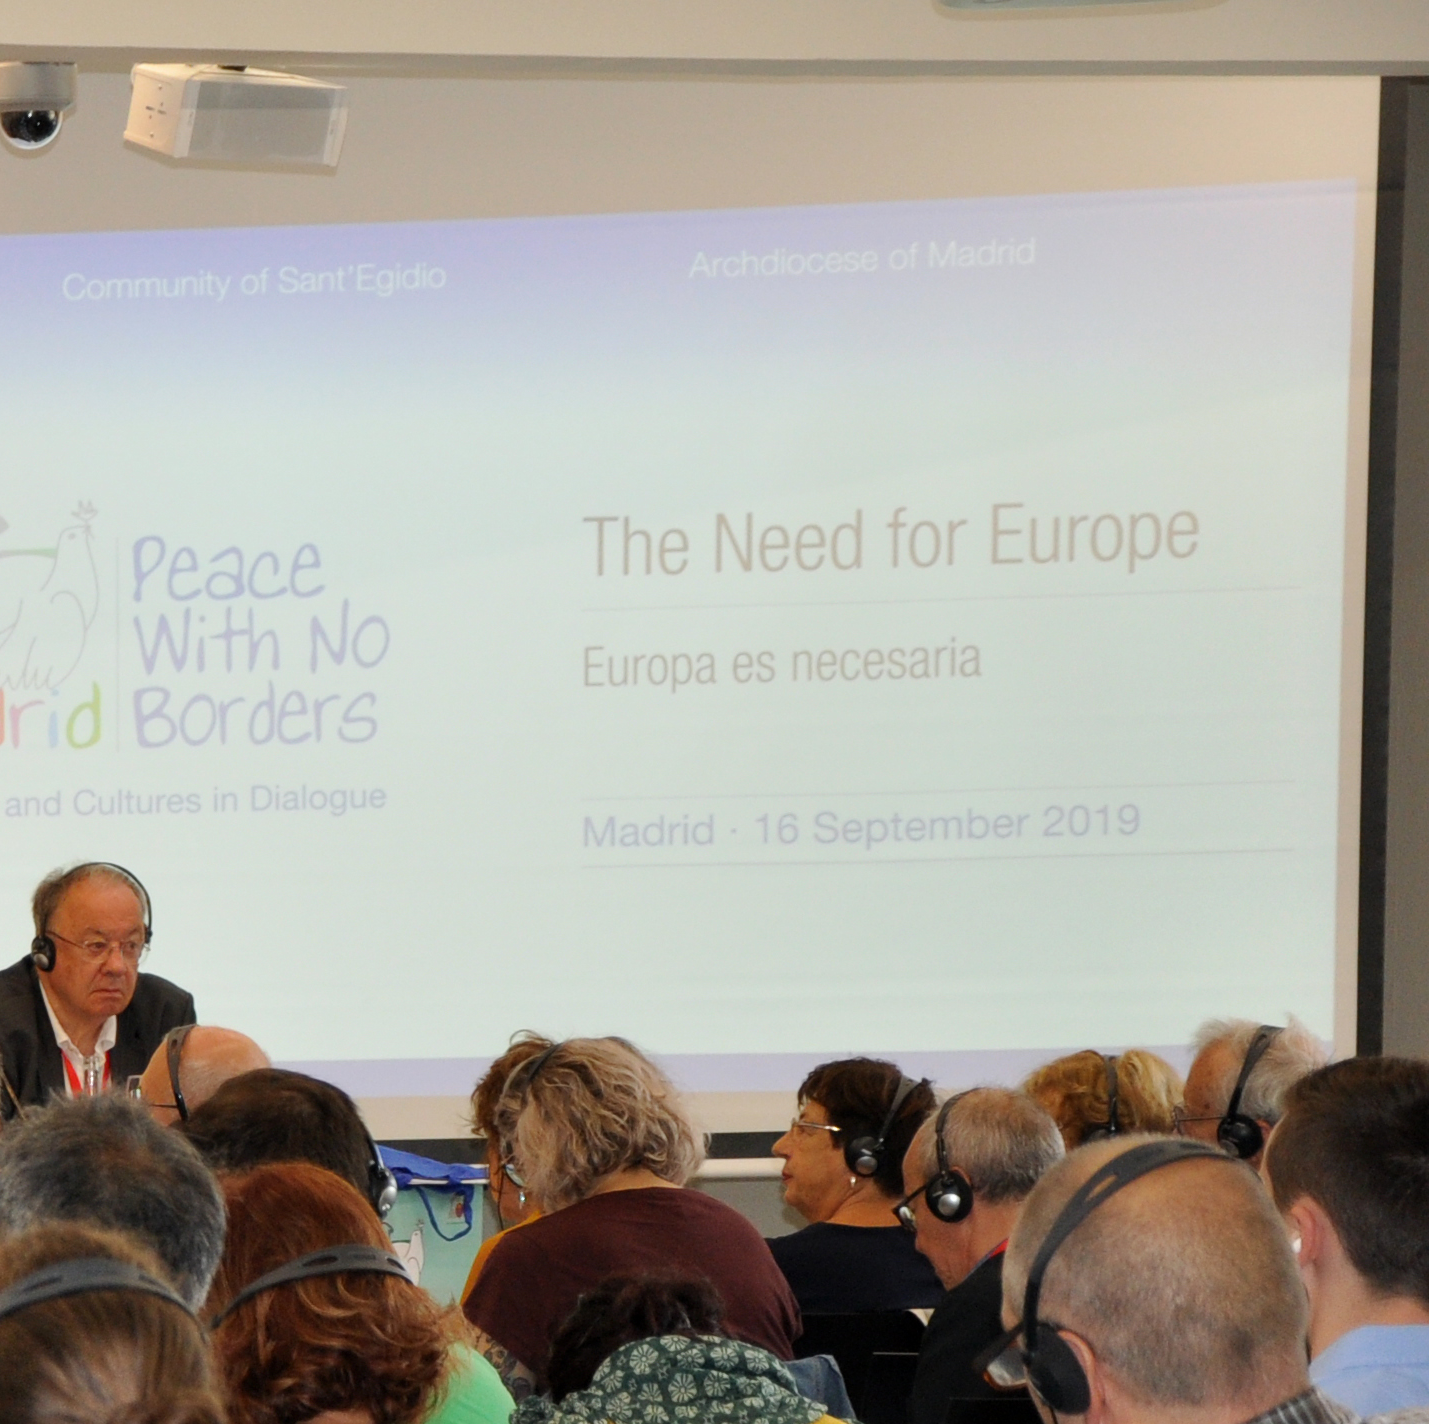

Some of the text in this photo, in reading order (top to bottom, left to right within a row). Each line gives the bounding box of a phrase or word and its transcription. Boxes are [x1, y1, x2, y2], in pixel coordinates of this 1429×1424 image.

[62, 263, 448, 302] Community of Sant'Egidio
[689, 238, 1036, 279] Archdiocese of Madrid
[581, 502, 1202, 577] The Need for Europe
[132, 535, 326, 603] Peace
[133, 598, 390, 675] With No
[581, 636, 983, 693] Europa es necesaria
[133, 680, 378, 748] Borders
[4, 789, 62, 819] and
[72, 787, 202, 816] Cultures
[213, 785, 238, 813] in
[250, 783, 388, 816] Dialogue
[582, 802, 1141, 851] Madrid 16 September 2019
